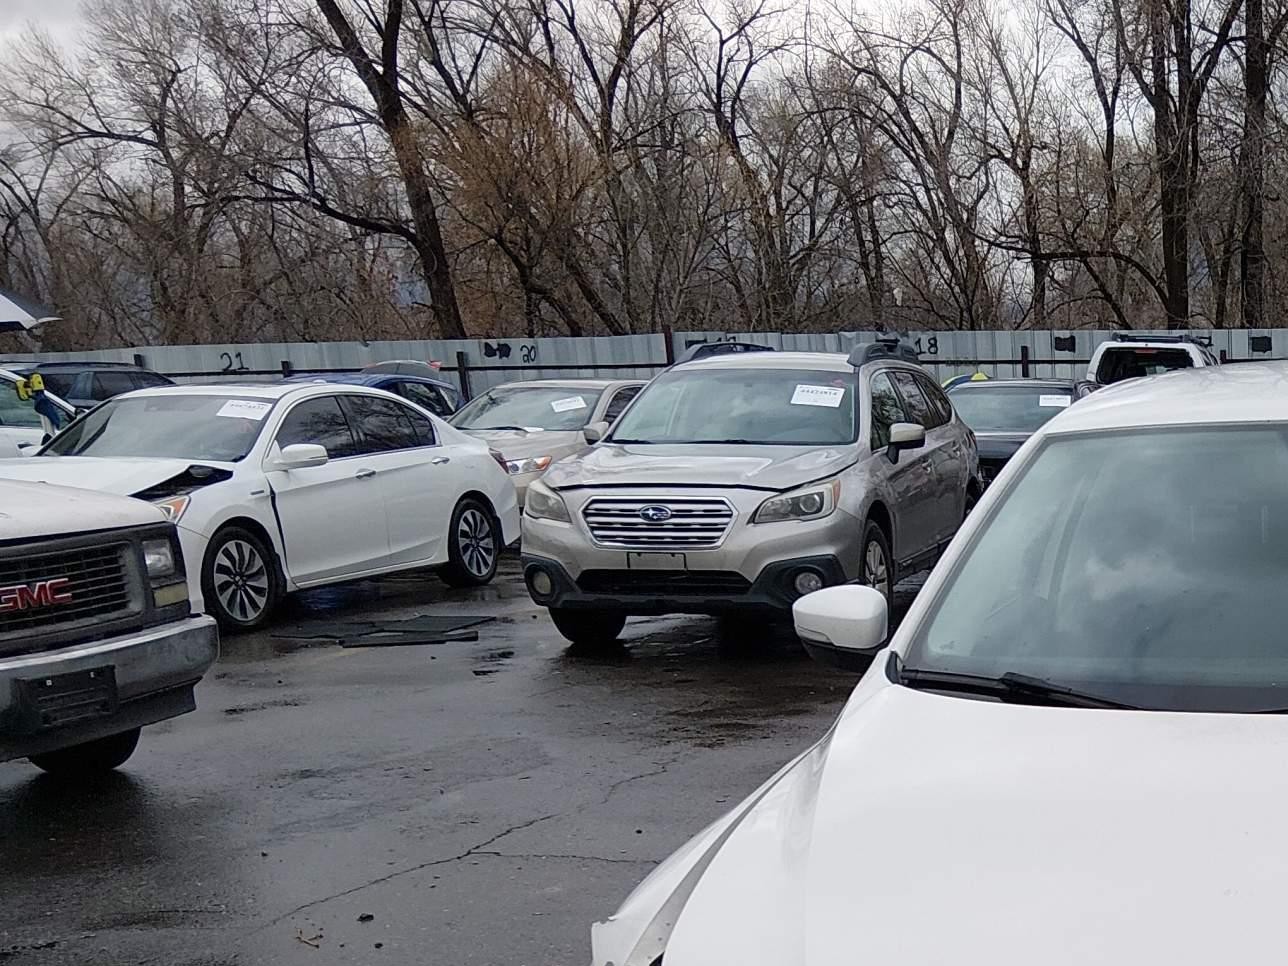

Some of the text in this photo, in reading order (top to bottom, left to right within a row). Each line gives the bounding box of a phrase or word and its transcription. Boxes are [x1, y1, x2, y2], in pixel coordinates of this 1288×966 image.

[520, 344, 537, 363] 20
[914, 336, 939, 355] 18
[220, 352, 250, 373] 21
[0, 577, 72, 614] GMC
